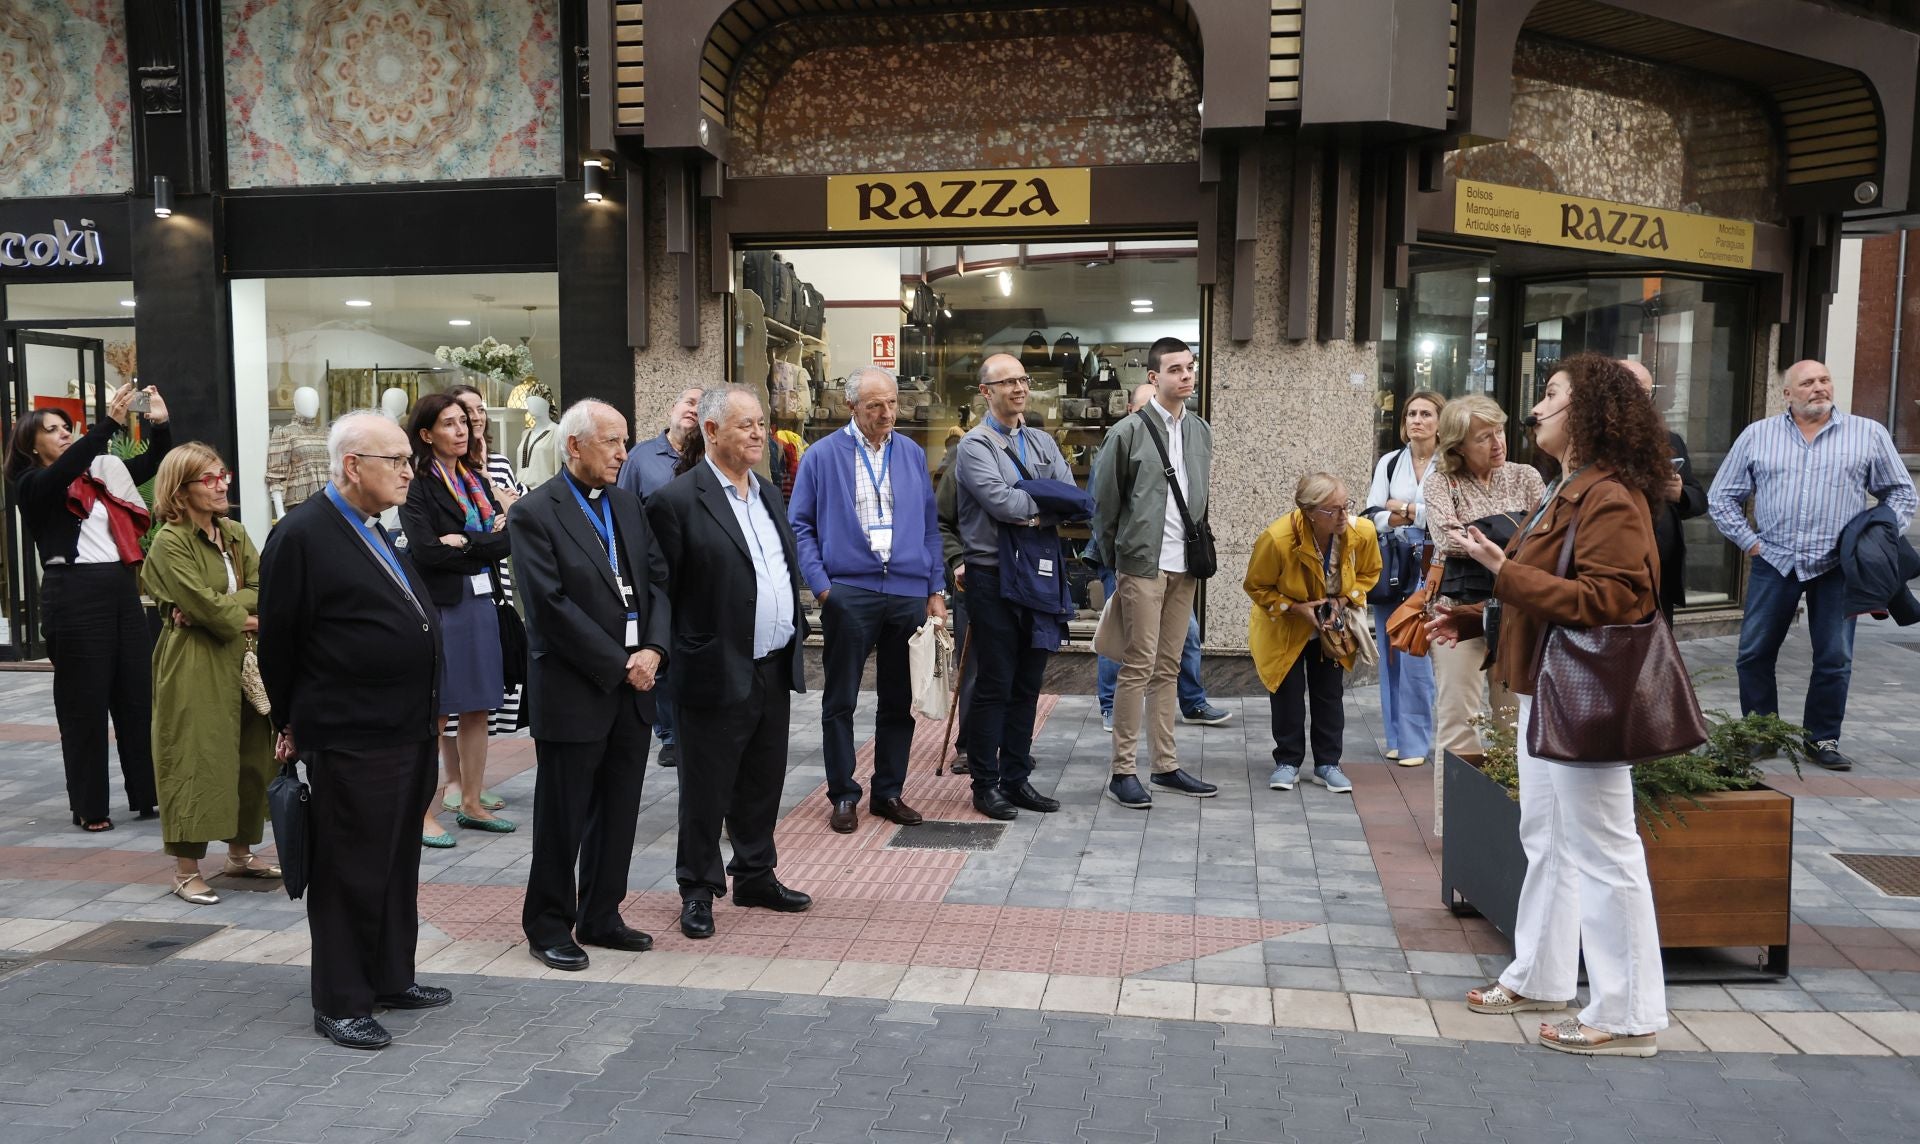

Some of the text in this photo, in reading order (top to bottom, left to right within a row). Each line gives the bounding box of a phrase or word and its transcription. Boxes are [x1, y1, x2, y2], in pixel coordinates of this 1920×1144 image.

[855, 178, 1060, 221] RAZZA
[1466, 186, 1494, 201] Bolsos
[1501, 222, 1511, 234] de
[1513, 223, 1532, 239] Viaje
[1560, 203, 1669, 251] RAZZA
[1718, 223, 1746, 237] Mochilas
[1715, 236, 1745, 251] Paraguas
[1698, 248, 1745, 264] Complementos
